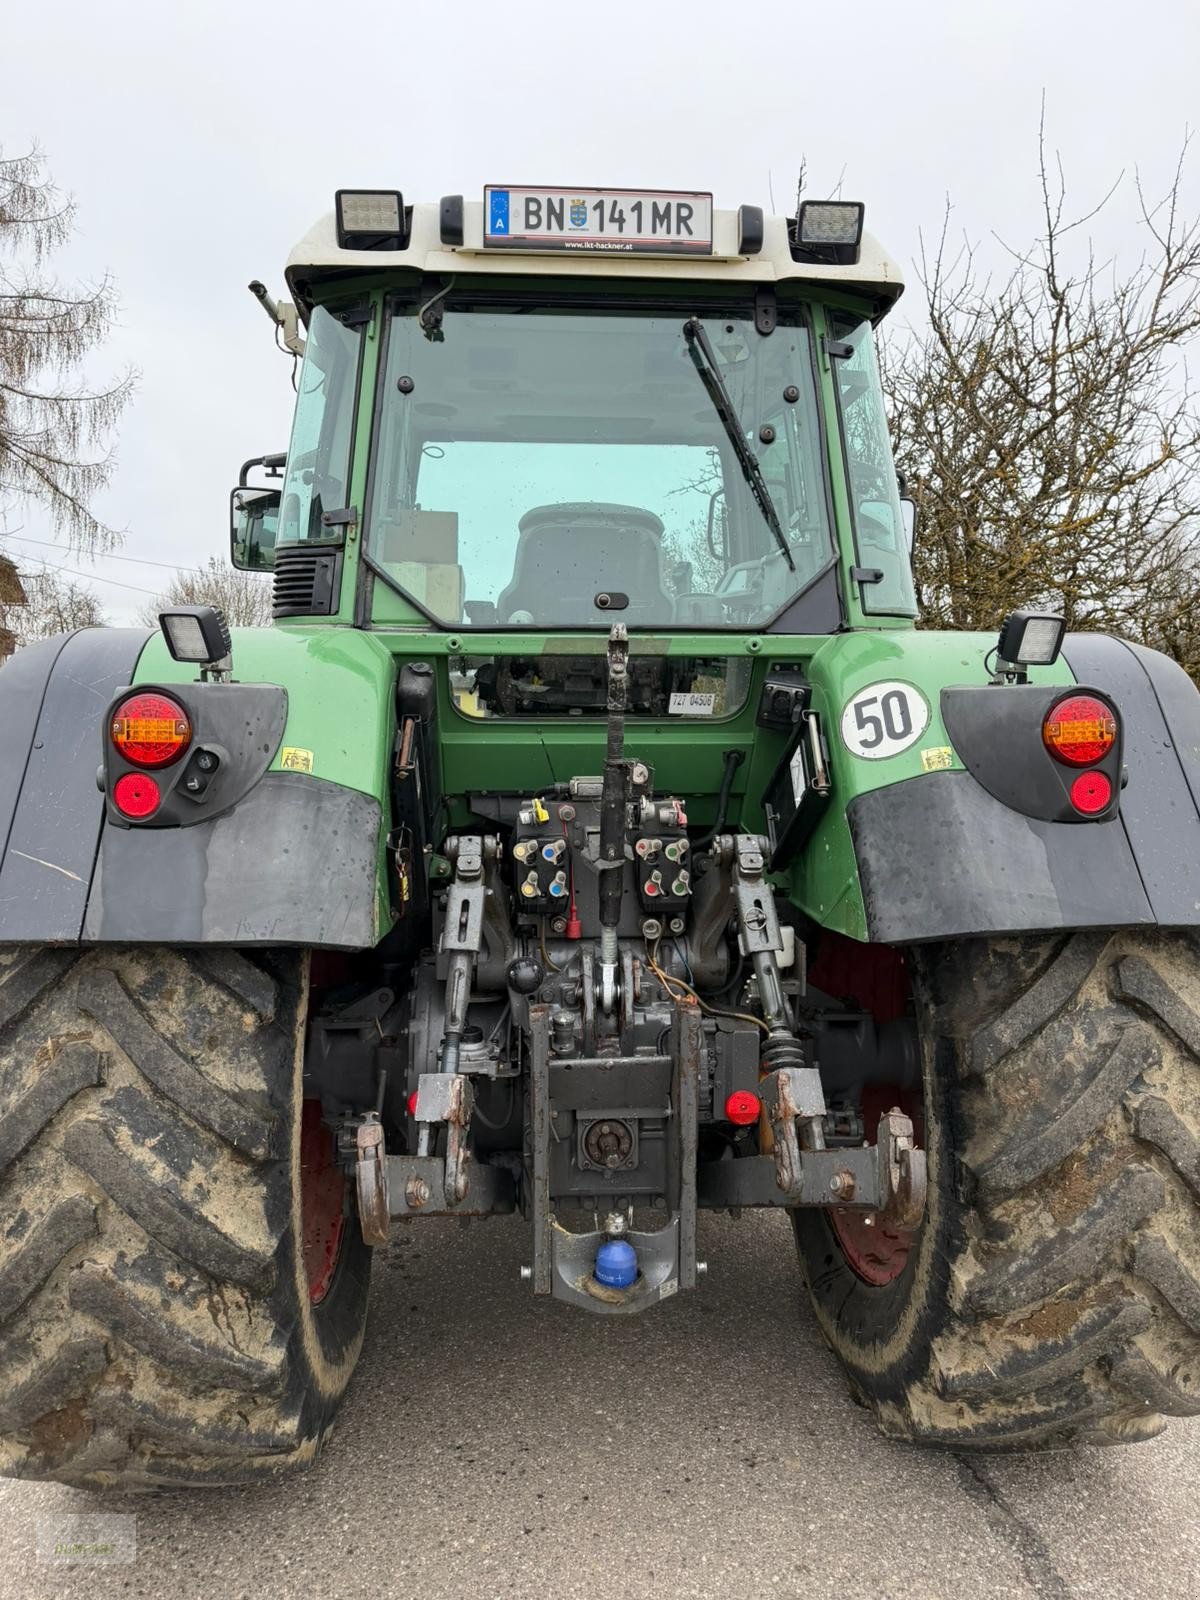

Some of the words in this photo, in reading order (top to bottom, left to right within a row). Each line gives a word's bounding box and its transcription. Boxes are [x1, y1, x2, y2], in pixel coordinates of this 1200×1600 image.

[495, 218, 505, 229] A
[524, 197, 564, 231] BN
[673, 694, 687, 706] 727
[854, 690, 913, 749] 50
